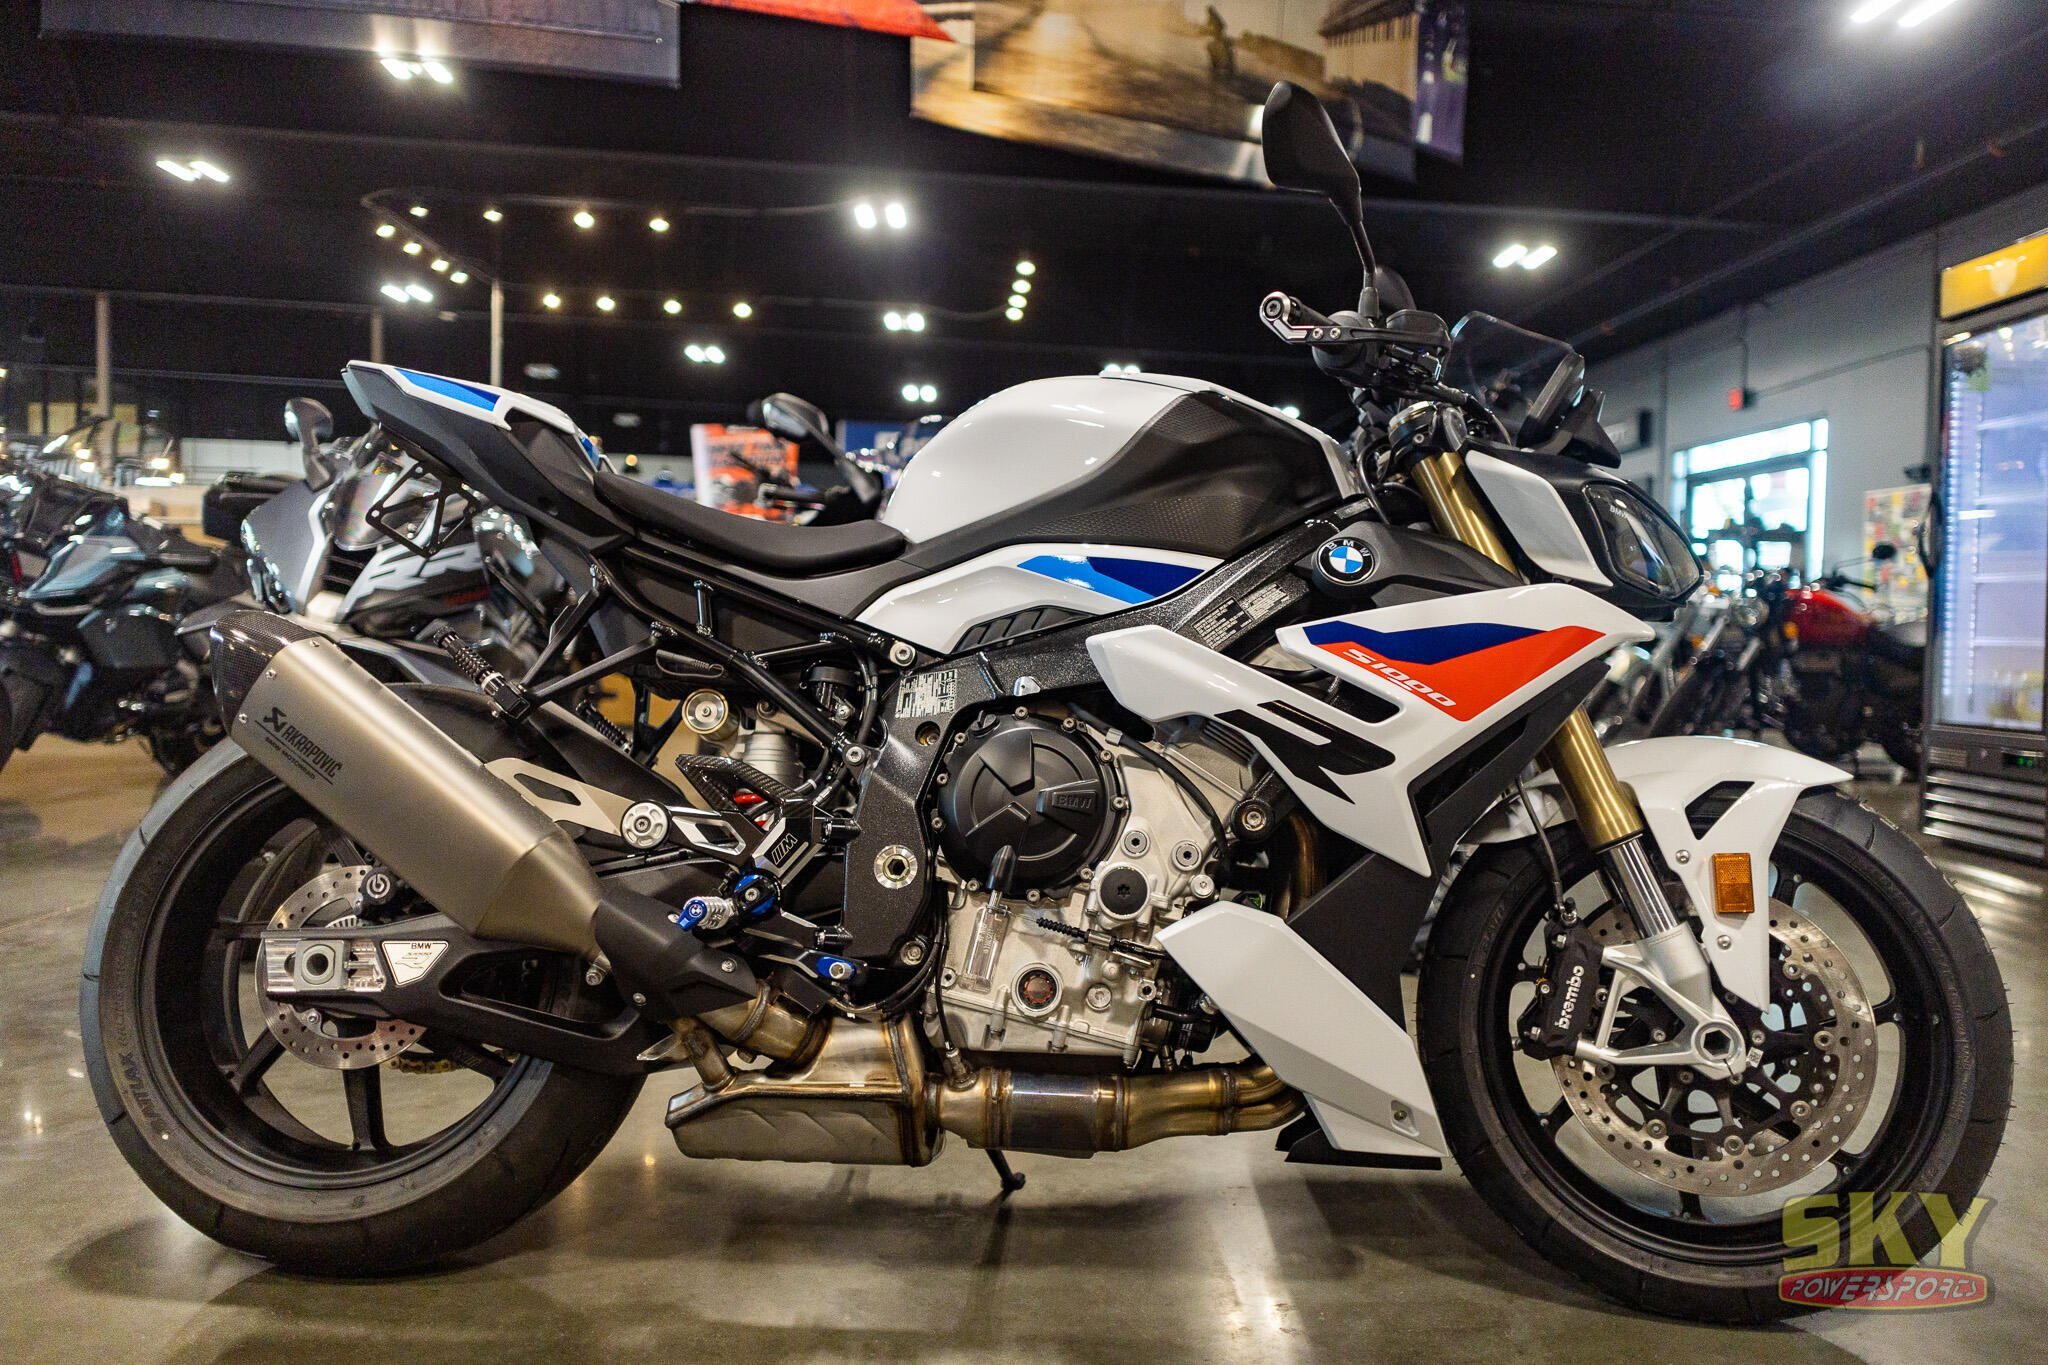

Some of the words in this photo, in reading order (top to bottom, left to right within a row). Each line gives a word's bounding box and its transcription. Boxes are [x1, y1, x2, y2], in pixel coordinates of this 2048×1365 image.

[1342, 648, 1456, 706] S1000
[1056, 794, 1094, 809] BMW
[411, 942, 431, 950] BMW
[1555, 965, 1584, 1030] brembo
